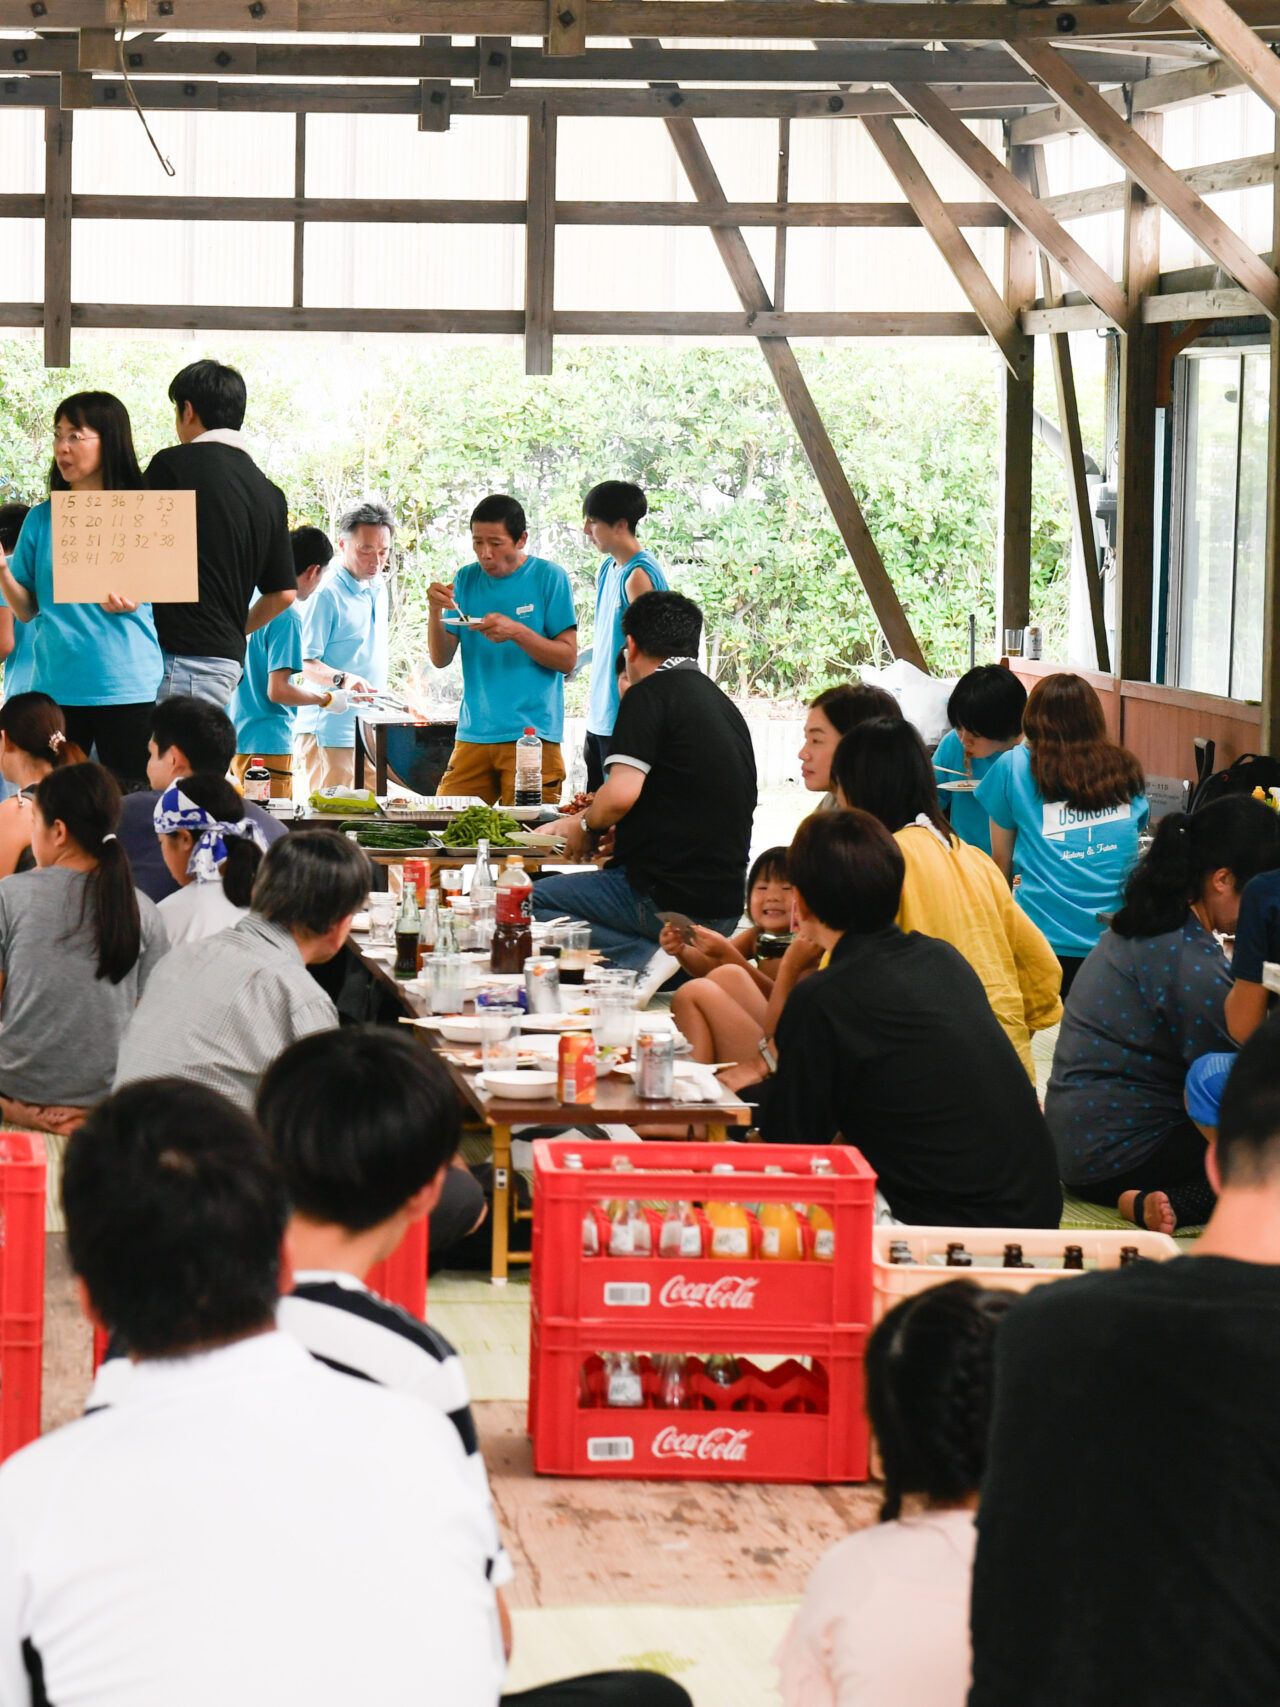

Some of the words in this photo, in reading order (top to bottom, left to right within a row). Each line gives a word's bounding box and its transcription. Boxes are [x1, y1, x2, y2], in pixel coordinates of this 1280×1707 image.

[60, 495, 77, 508] 15
[85, 495, 102, 507] 52
[112, 495, 126, 507] 36
[61, 514, 79, 528] 75
[85, 515, 103, 527] 20
[86, 534, 101, 547] 51
[135, 534, 149, 549] 32
[86, 551, 99, 566] 41
[658, 1275, 760, 1309] Coca-Cola
[651, 1426, 754, 1461] Coca-Cola
